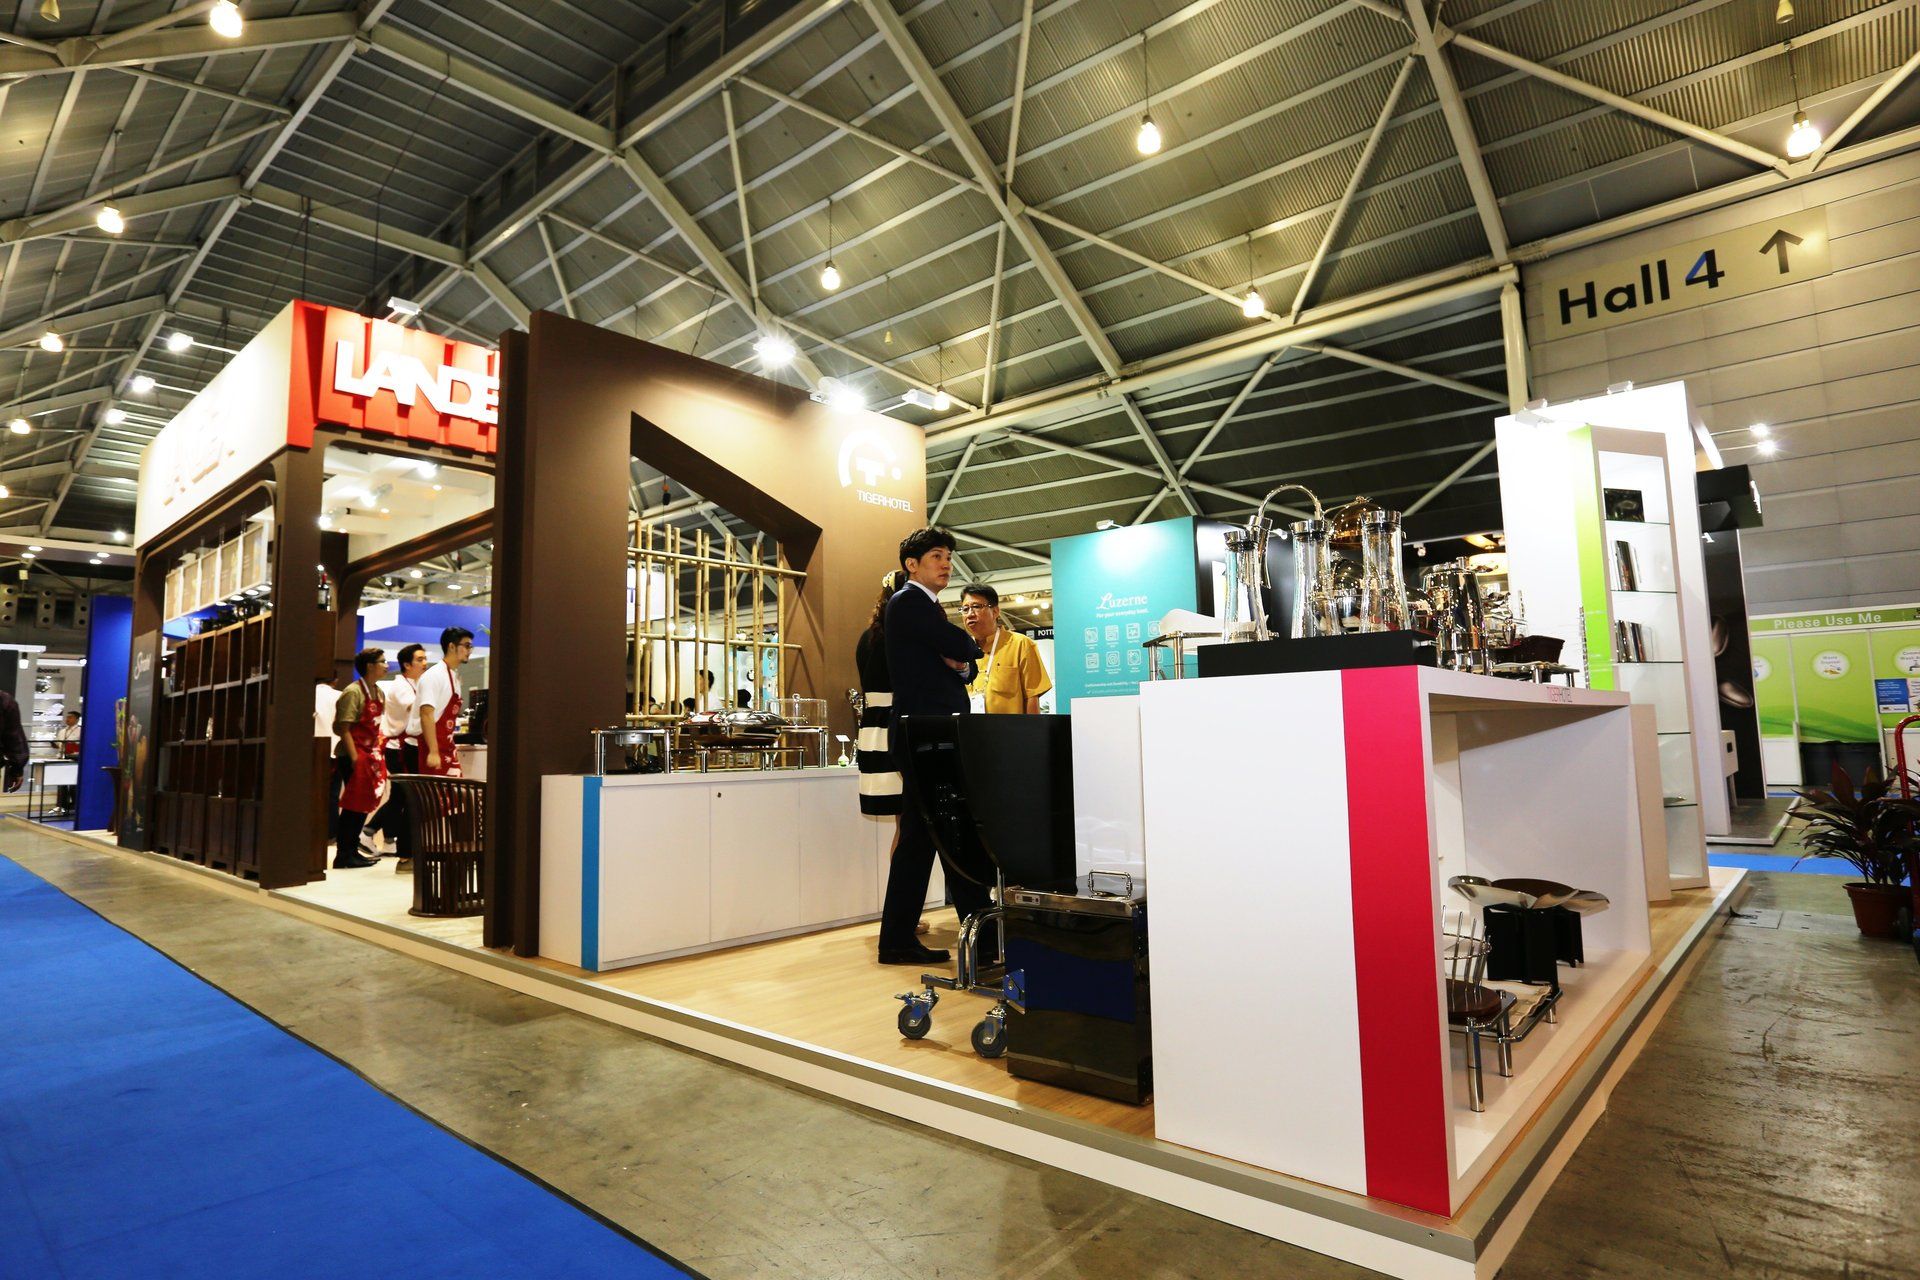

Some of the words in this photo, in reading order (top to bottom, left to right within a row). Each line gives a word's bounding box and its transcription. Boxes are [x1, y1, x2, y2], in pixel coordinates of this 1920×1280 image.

[1558, 259, 1671, 325] Hall
[1685, 248, 1725, 289] 4
[857, 489, 914, 513] TIGERHOTEL
[1096, 592, 1148, 610] Luzerne
[1774, 618, 1820, 629] Please
[1826, 616, 1853, 626] Use
[1858, 612, 1882, 623] Me
